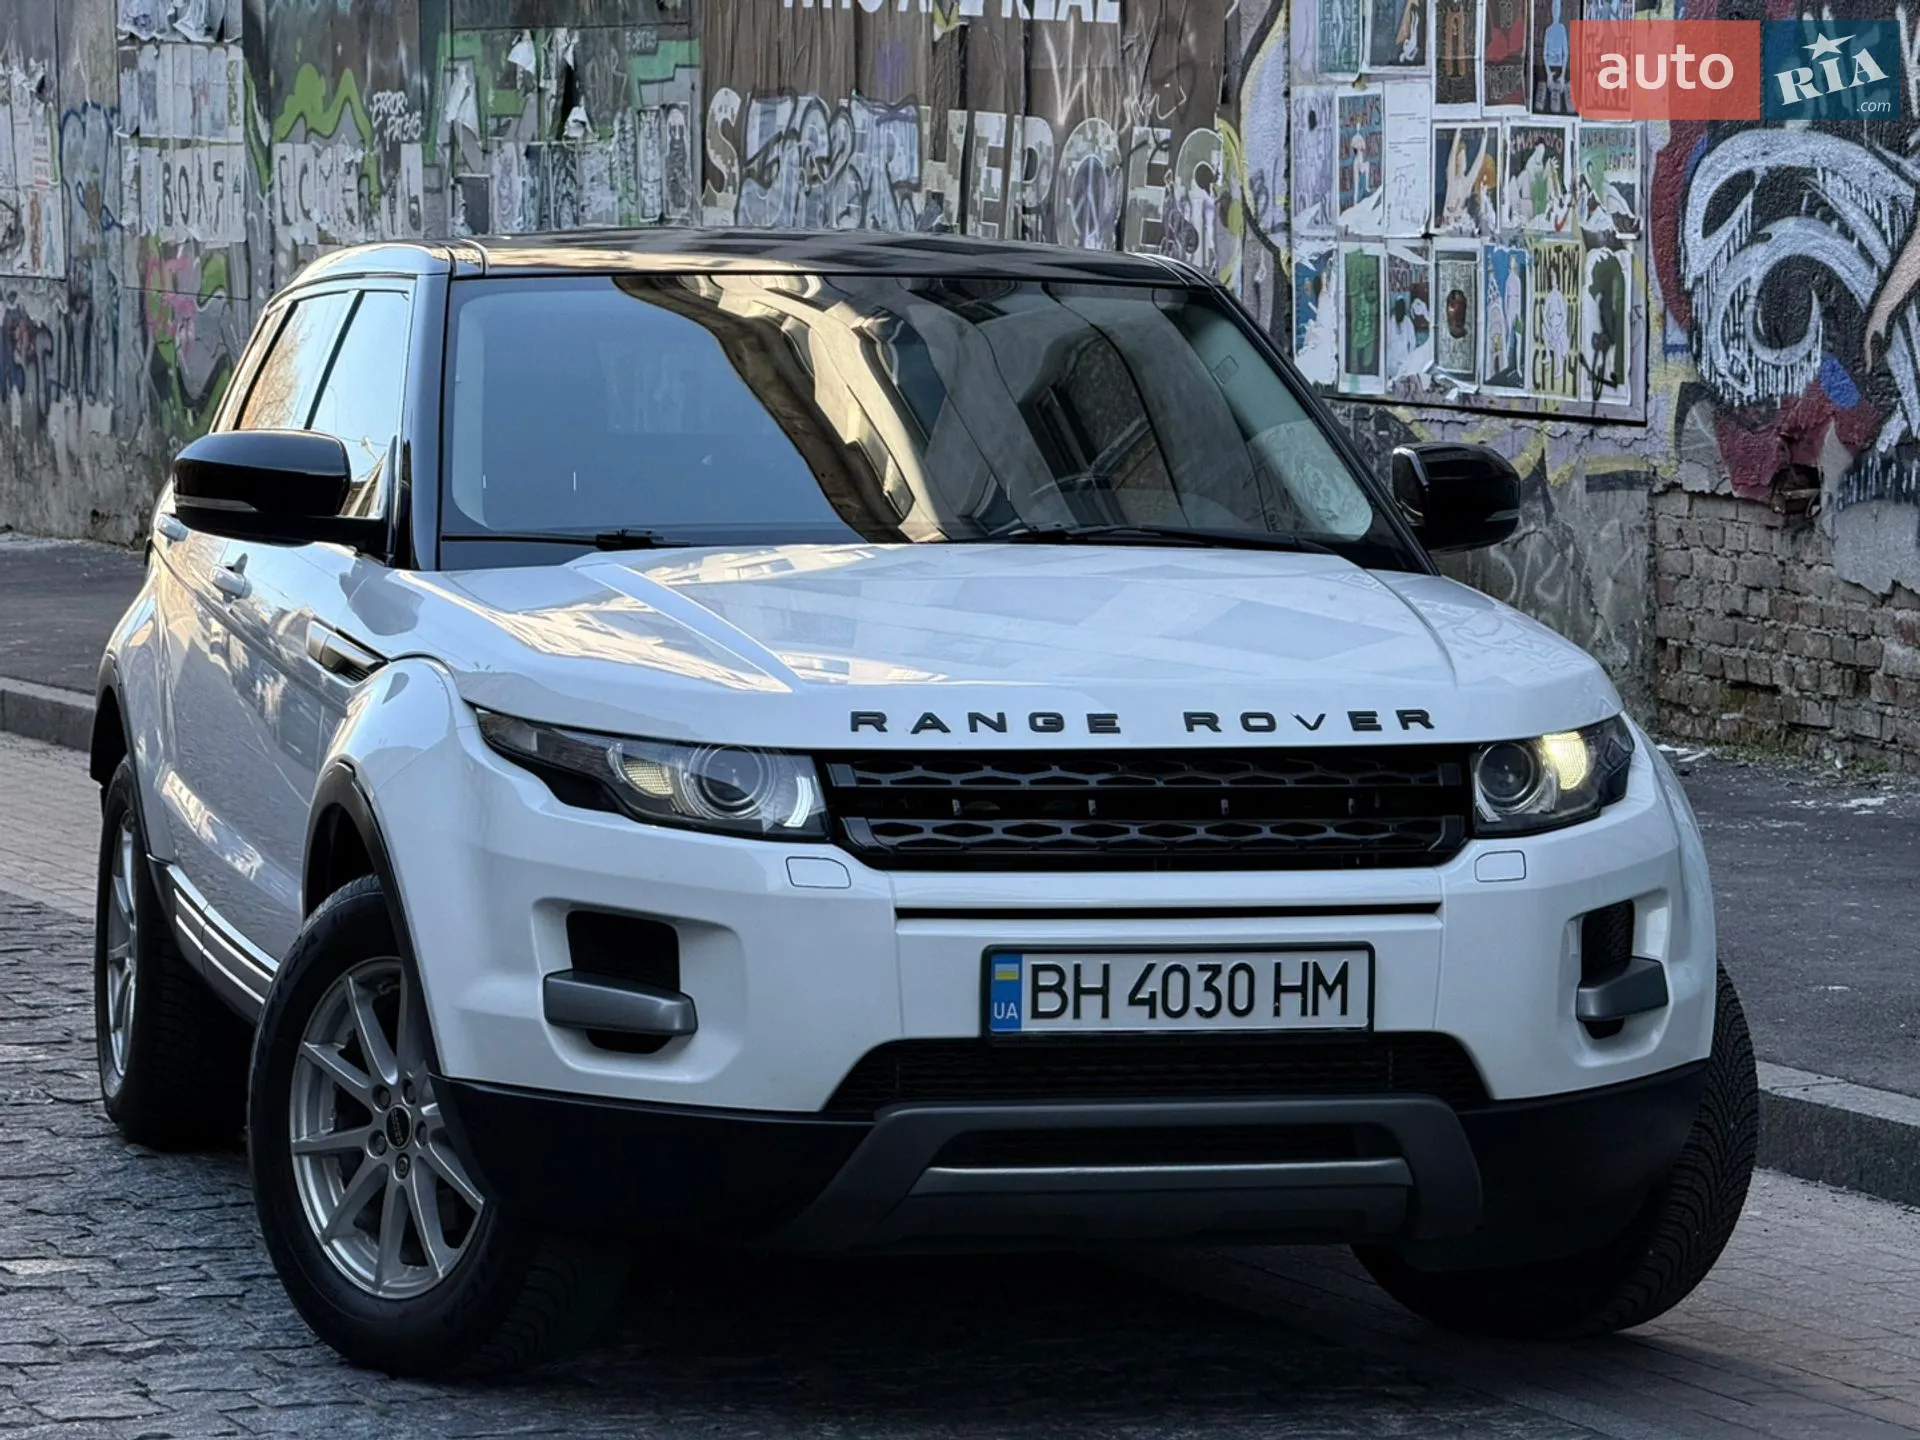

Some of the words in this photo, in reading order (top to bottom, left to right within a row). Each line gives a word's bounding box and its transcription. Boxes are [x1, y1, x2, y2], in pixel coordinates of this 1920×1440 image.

[849, 710, 1121, 735] RANGE
[1183, 708, 1435, 733] ROVER
[1030, 962, 1110, 1019] BH
[1127, 962, 1256, 1019] 4030
[1273, 960, 1349, 1017] HM
[993, 1002, 1019, 1020] UA
